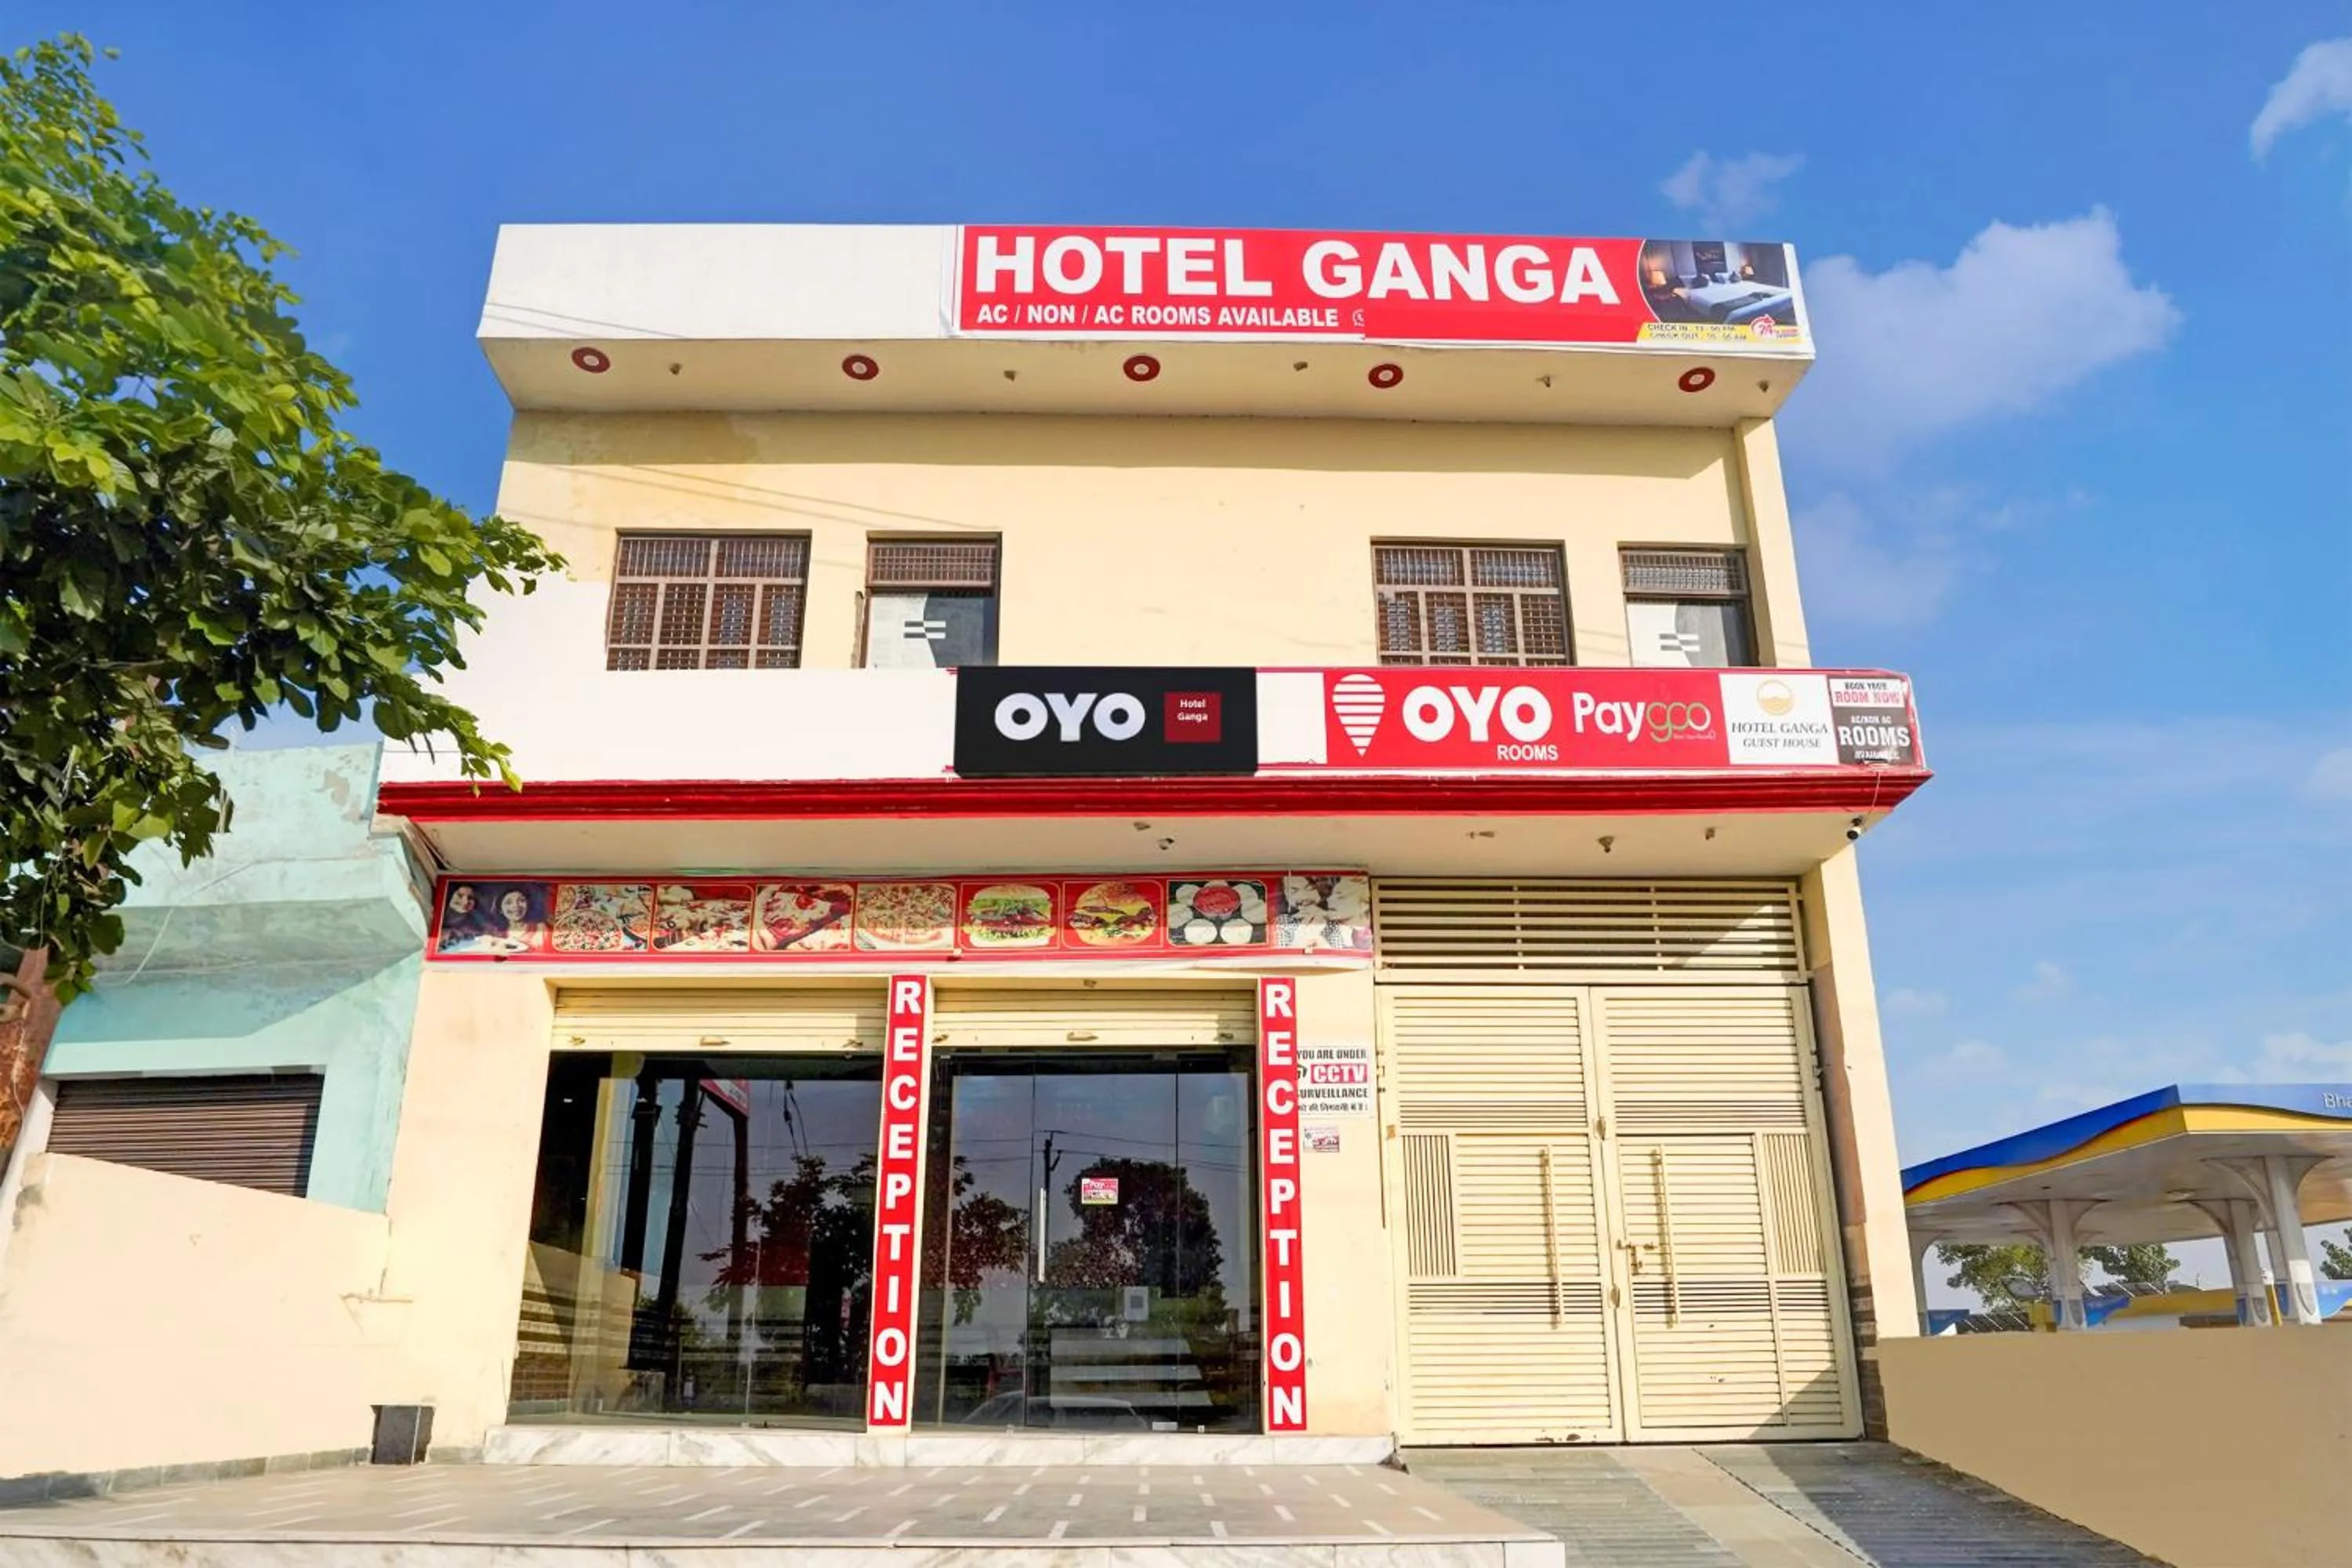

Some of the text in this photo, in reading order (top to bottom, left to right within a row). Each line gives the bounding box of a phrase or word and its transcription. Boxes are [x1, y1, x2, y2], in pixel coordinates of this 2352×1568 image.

[975, 235, 1621, 305] HOTEL GANGA
[977, 304, 1007, 324] AC
[1028, 304, 1075, 324] NON
[1094, 305, 1123, 324] AC
[1131, 306, 1210, 325] ROOMS
[1218, 307, 1339, 327] AVAILABLE
[1180, 699, 1206, 708] Hotel
[1834, 691, 1900, 703] ROOM NOW
[994, 692, 1145, 742] OYO
[1178, 712, 1208, 723] Ganga
[1402, 686, 1552, 742] OYO
[1732, 722, 1828, 735] HOTEL GANGA
[1838, 725, 1911, 746] ROOMS
[1497, 744, 1559, 760] ROOMS
[1742, 738, 1822, 749] GUEST HOUSE
[1298, 1049, 1367, 1059] YOU ARE UNDER
[1313, 1065, 1365, 1083] CCTV
[1298, 1087, 1368, 1098] URVEILLANCE
[873, 981, 922, 1420] RECEPTION
[1265, 984, 1302, 1425] RECEPTION
